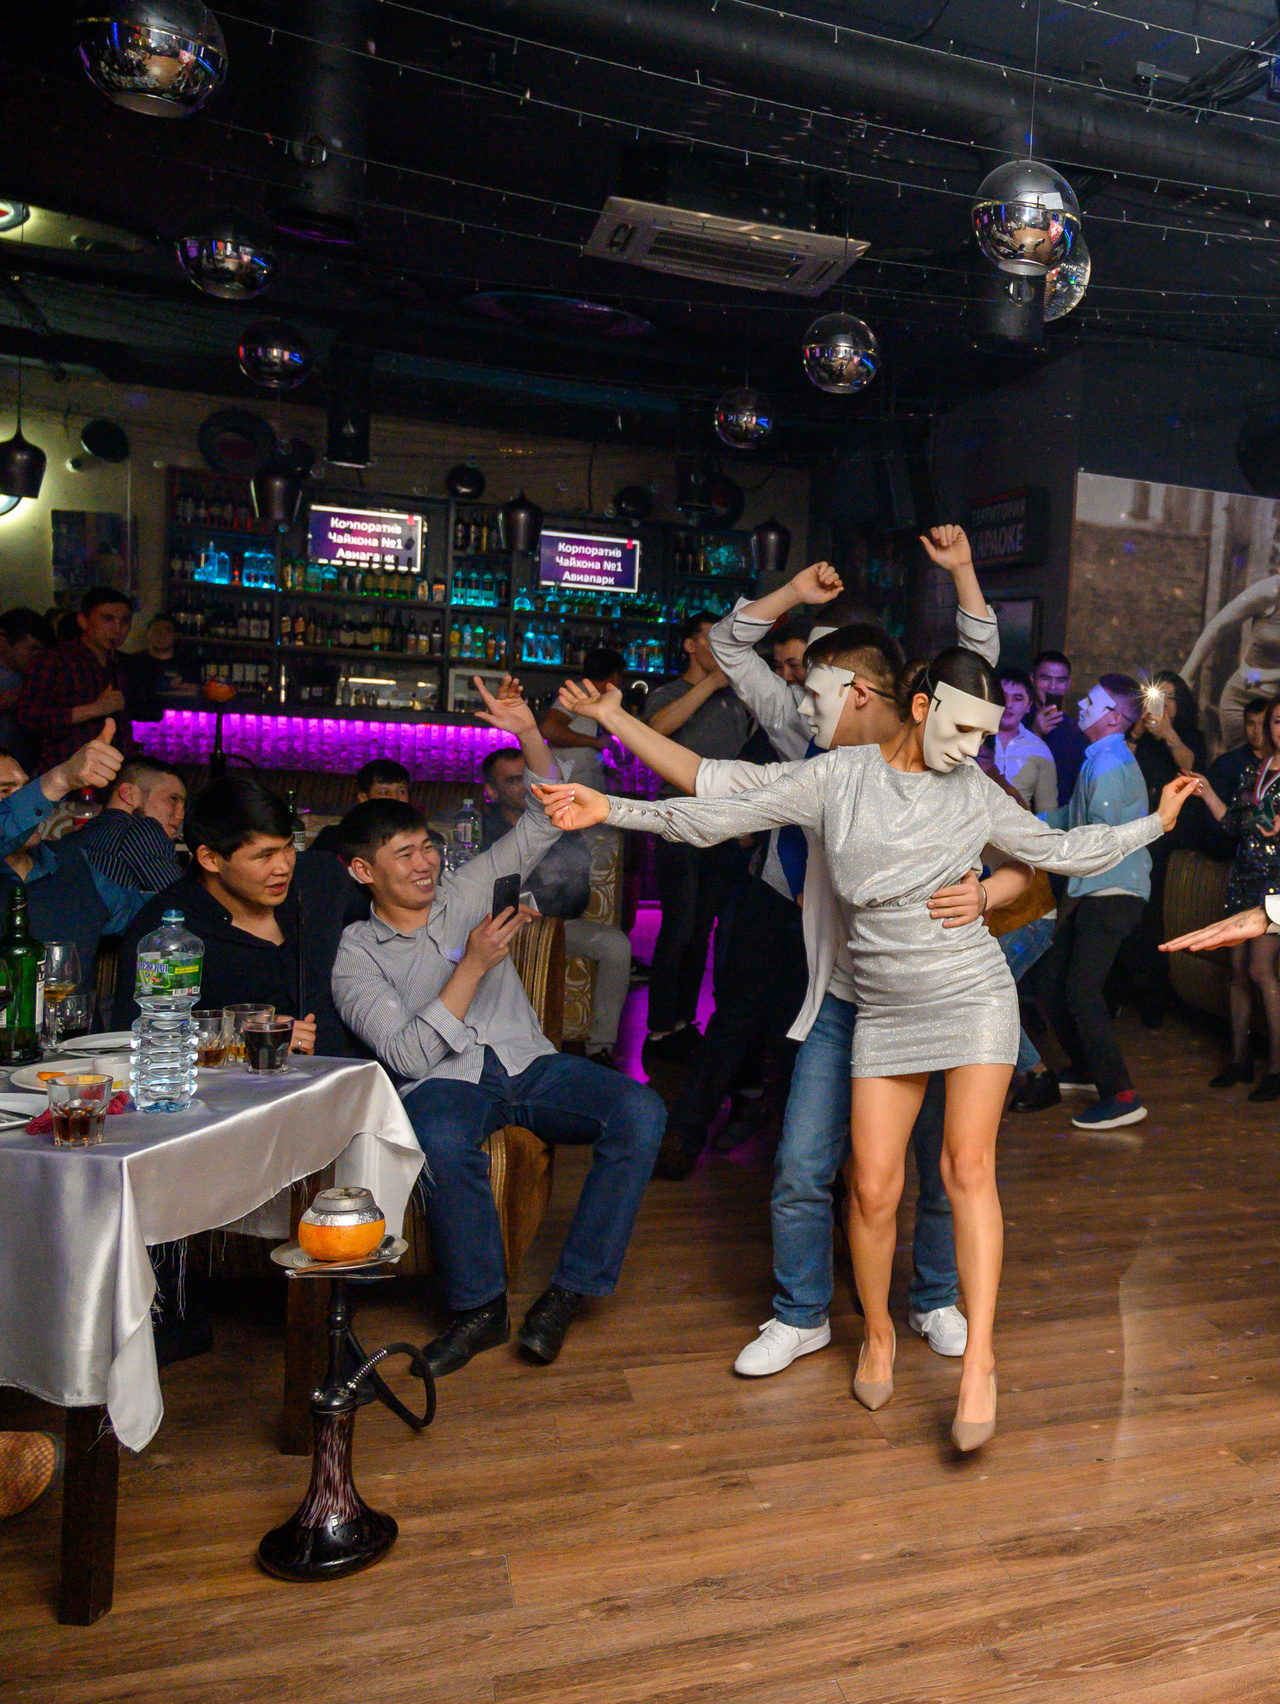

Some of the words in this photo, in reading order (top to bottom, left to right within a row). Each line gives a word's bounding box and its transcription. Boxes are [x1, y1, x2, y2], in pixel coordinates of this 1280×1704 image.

[328, 531, 379, 547] Чайхона
[381, 537, 403, 550] №1
[558, 542, 622, 558] Корпоратив
[555, 556, 600, 570] Чайхона
[603, 560, 623, 572] №1
[563, 570, 615, 586] Авиапарк
